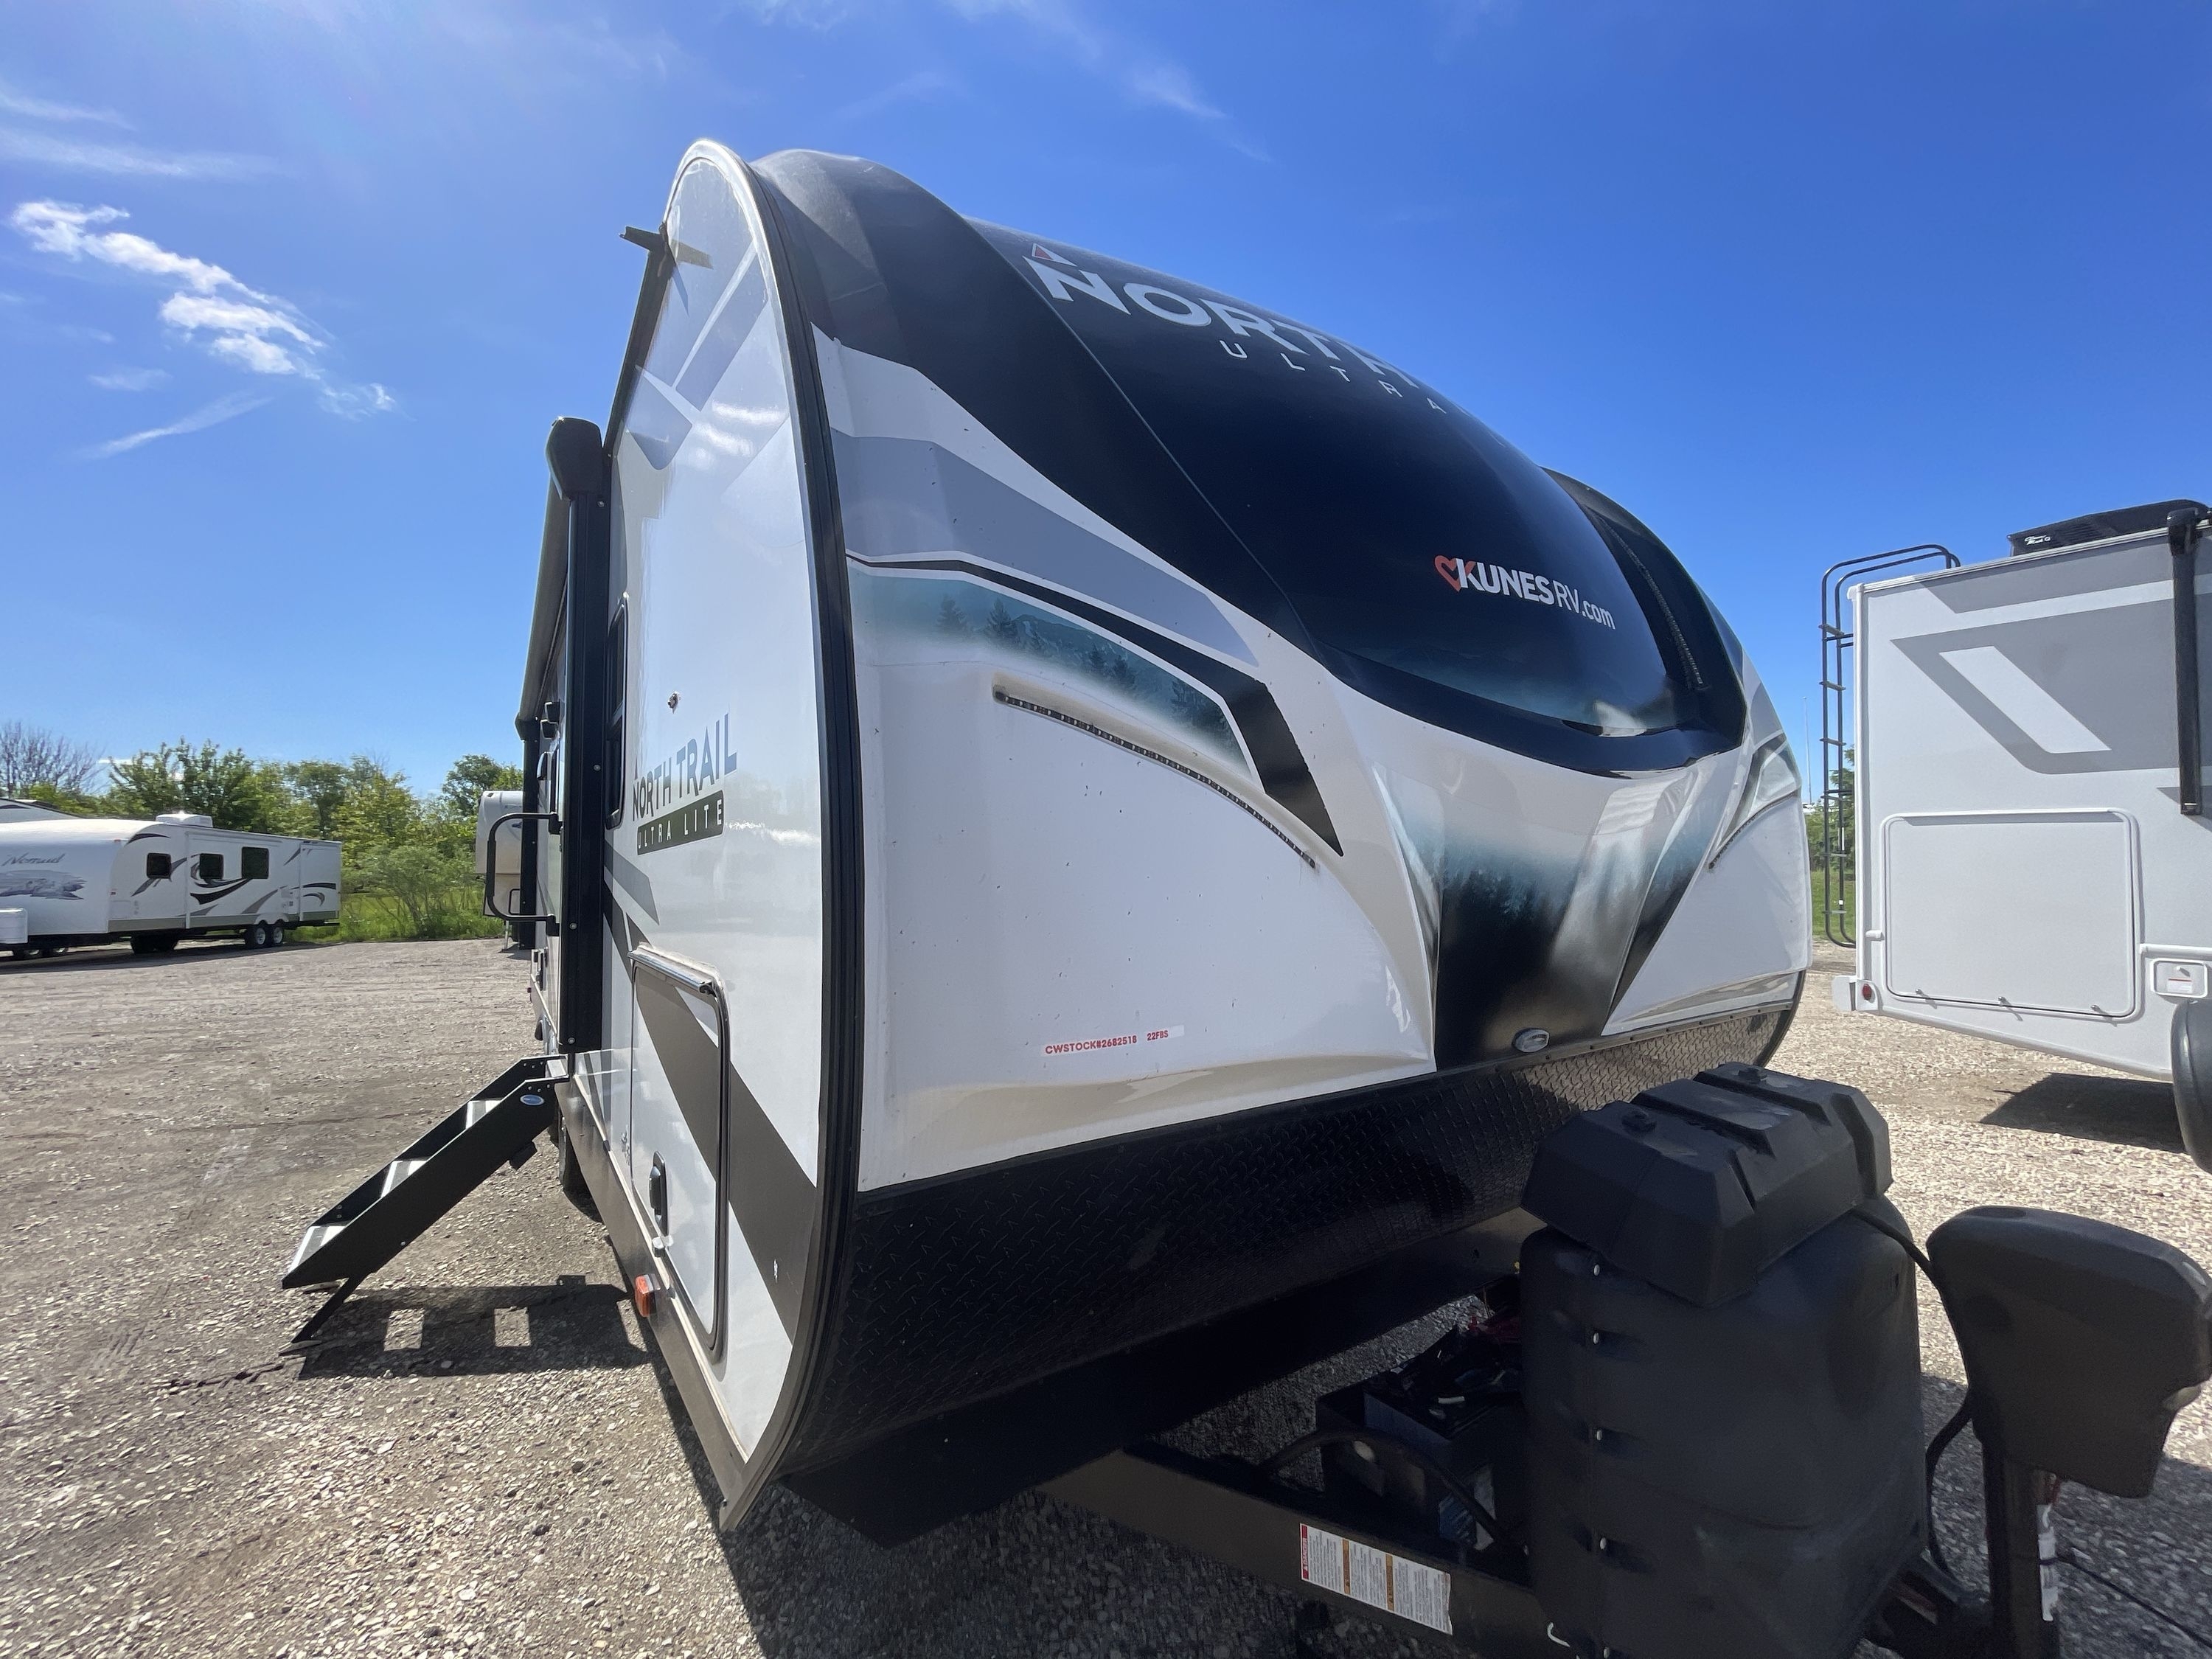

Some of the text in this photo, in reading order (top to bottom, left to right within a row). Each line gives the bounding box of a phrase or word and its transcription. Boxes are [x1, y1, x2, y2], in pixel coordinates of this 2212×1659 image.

[1023, 255, 1419, 389] NORTH
[1220, 339, 1447, 414] ULTRA
[633, 712, 737, 821] NORTH TRAIL
[638, 799, 722, 849] ULTRA LITE
